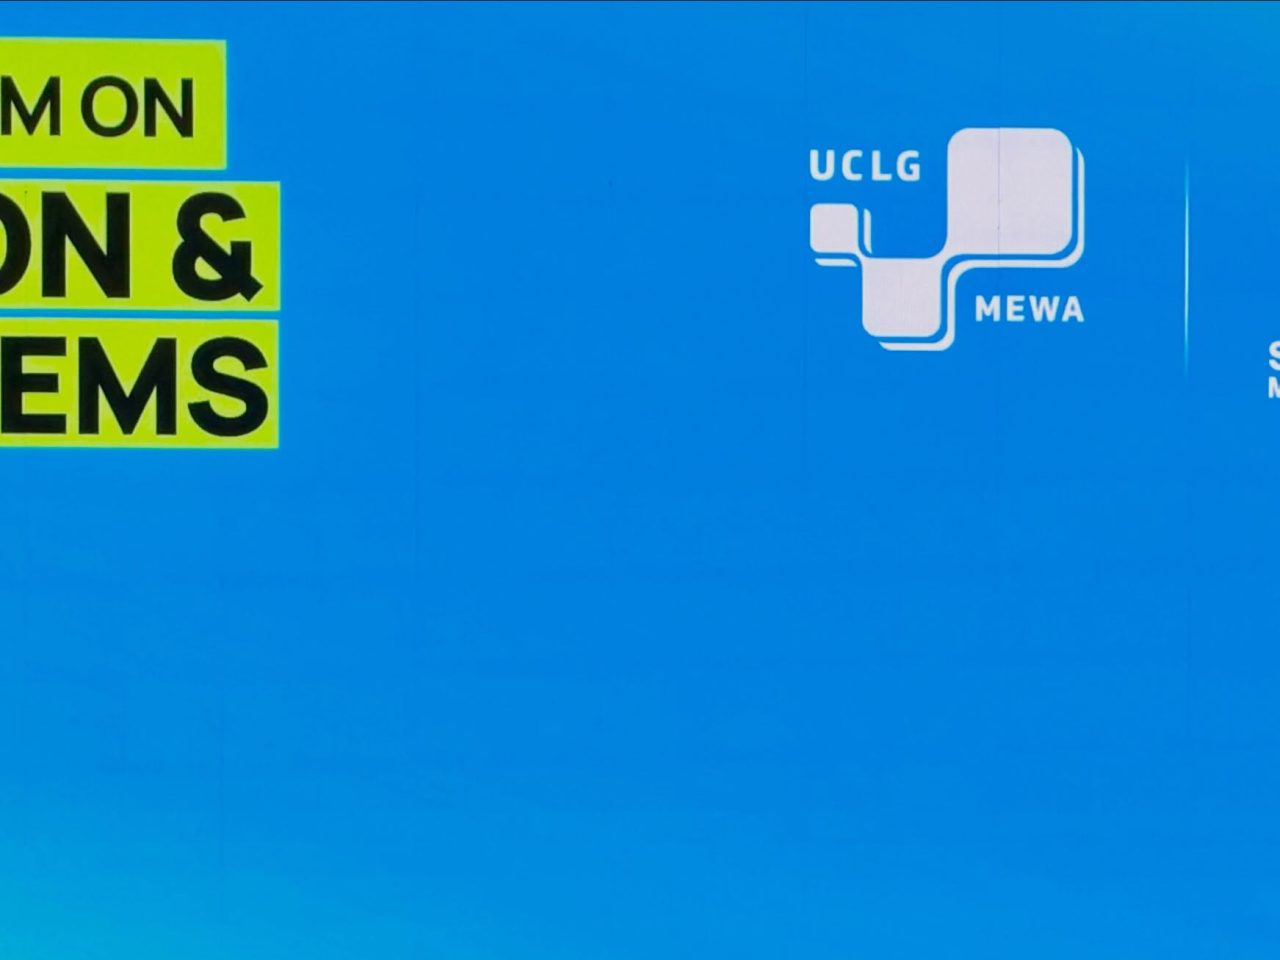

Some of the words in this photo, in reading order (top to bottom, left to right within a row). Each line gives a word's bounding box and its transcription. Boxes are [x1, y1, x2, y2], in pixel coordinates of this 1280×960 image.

[81, 75, 194, 137] ON
[810, 149, 921, 182] UCLG
[172, 191, 264, 302] &
[975, 296, 1085, 322] MEWA
[0, 336, 269, 437] EMS
